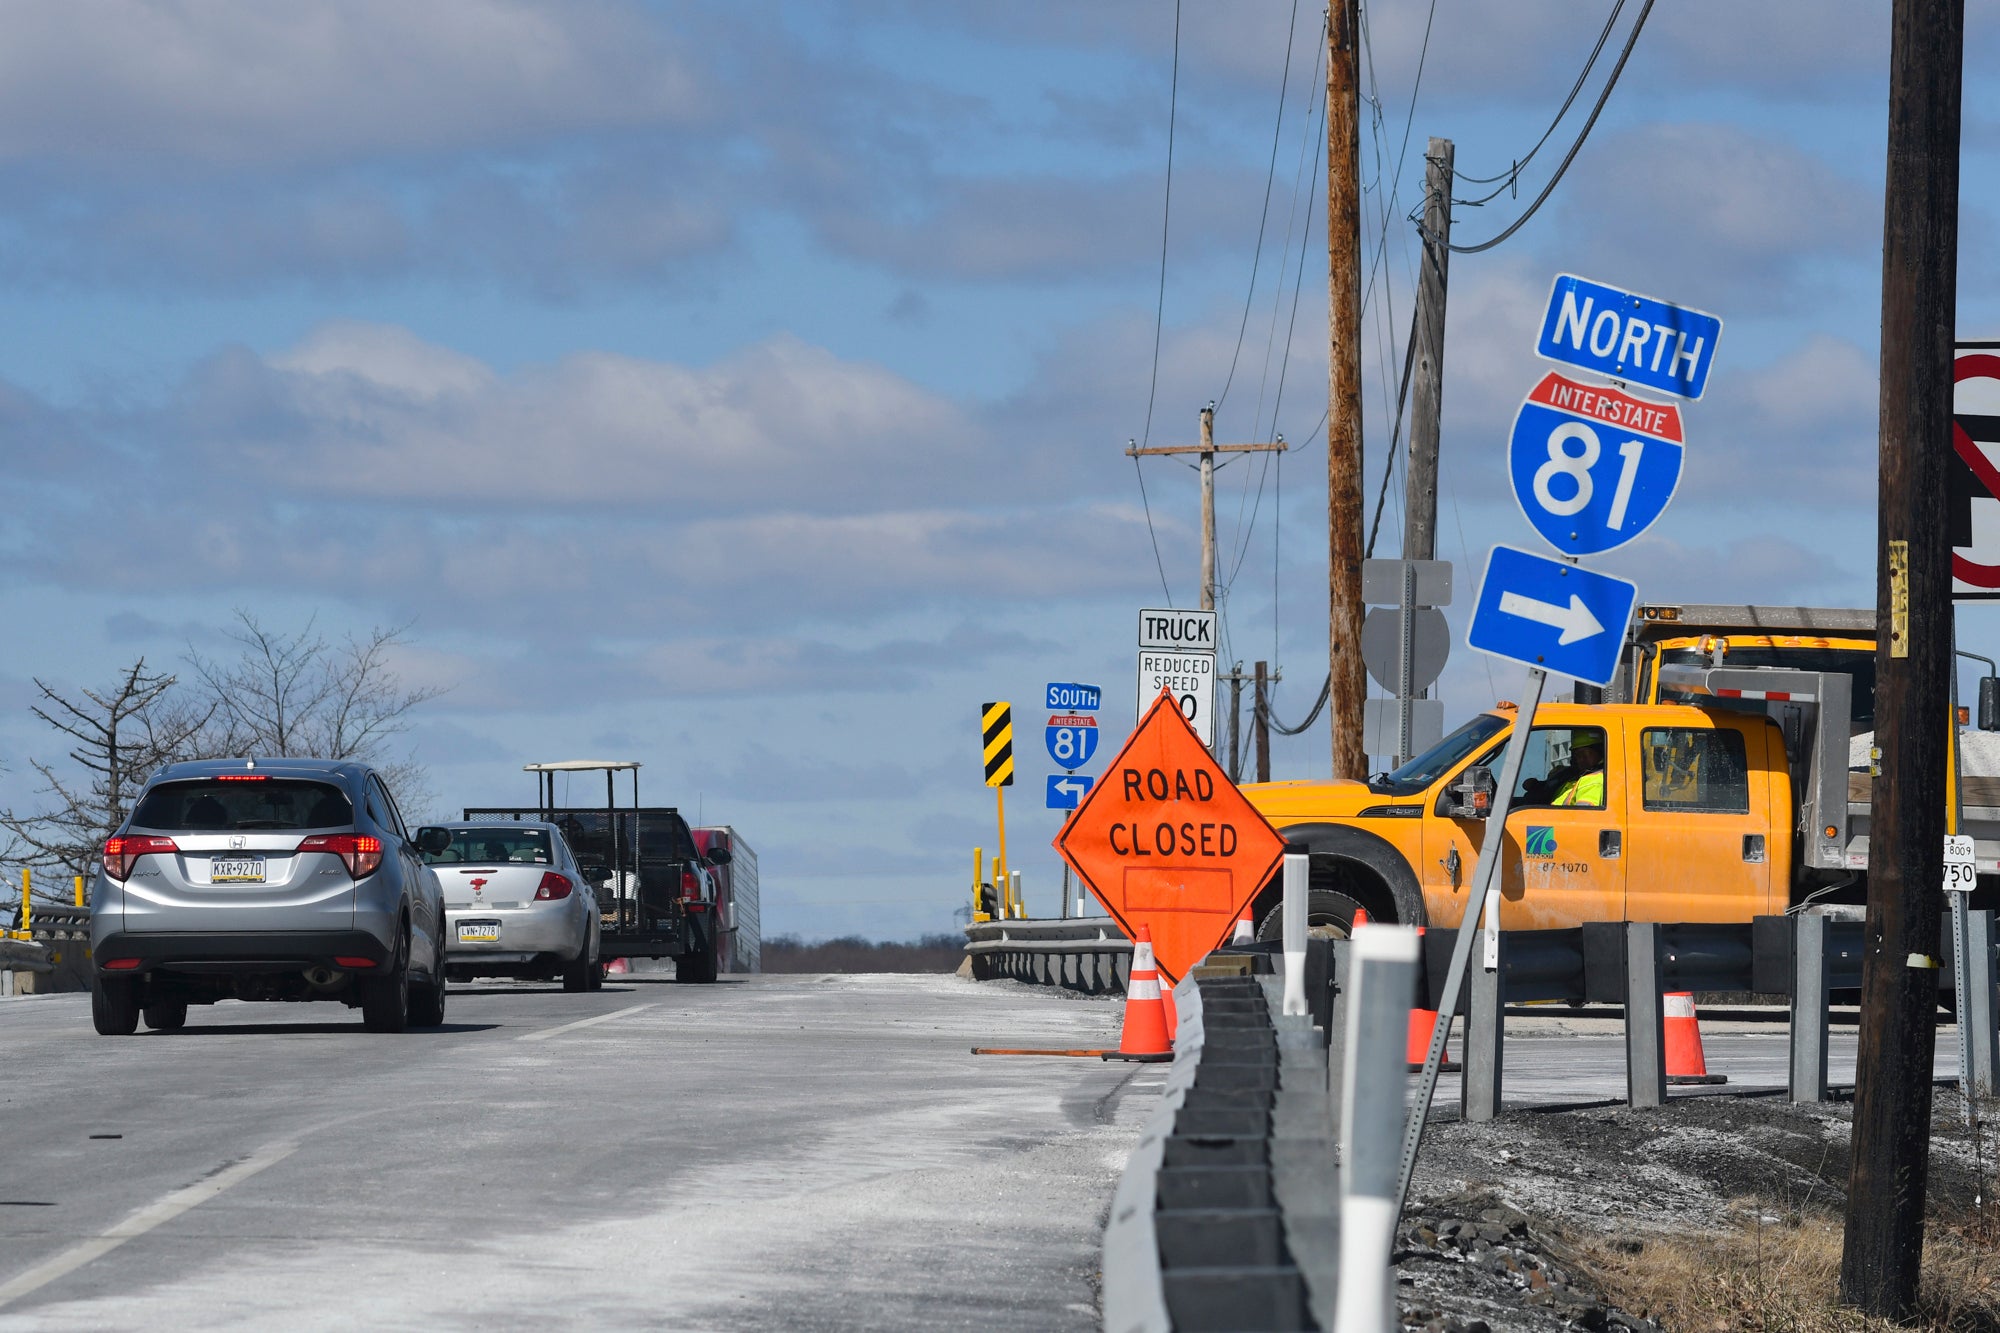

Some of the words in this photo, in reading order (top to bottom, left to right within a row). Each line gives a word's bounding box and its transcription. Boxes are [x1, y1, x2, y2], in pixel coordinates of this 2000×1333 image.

[1552, 291, 1705, 383] NORTH
[1549, 382, 1668, 435] INTERSTATE
[1533, 421, 1645, 531] 81
[1145, 617, 1210, 642] TRUCK
[1144, 657, 1210, 674] REDUCED
[1049, 687, 1098, 706] SOUTH
[1153, 675, 1199, 691] SPEED
[1053, 718, 1091, 726] INTERSTATE
[1054, 728, 1087, 759] 81
[1123, 768, 1214, 802] ROAD
[1109, 822, 1238, 857] CLOSED
[1949, 845, 1971, 856] 8009
